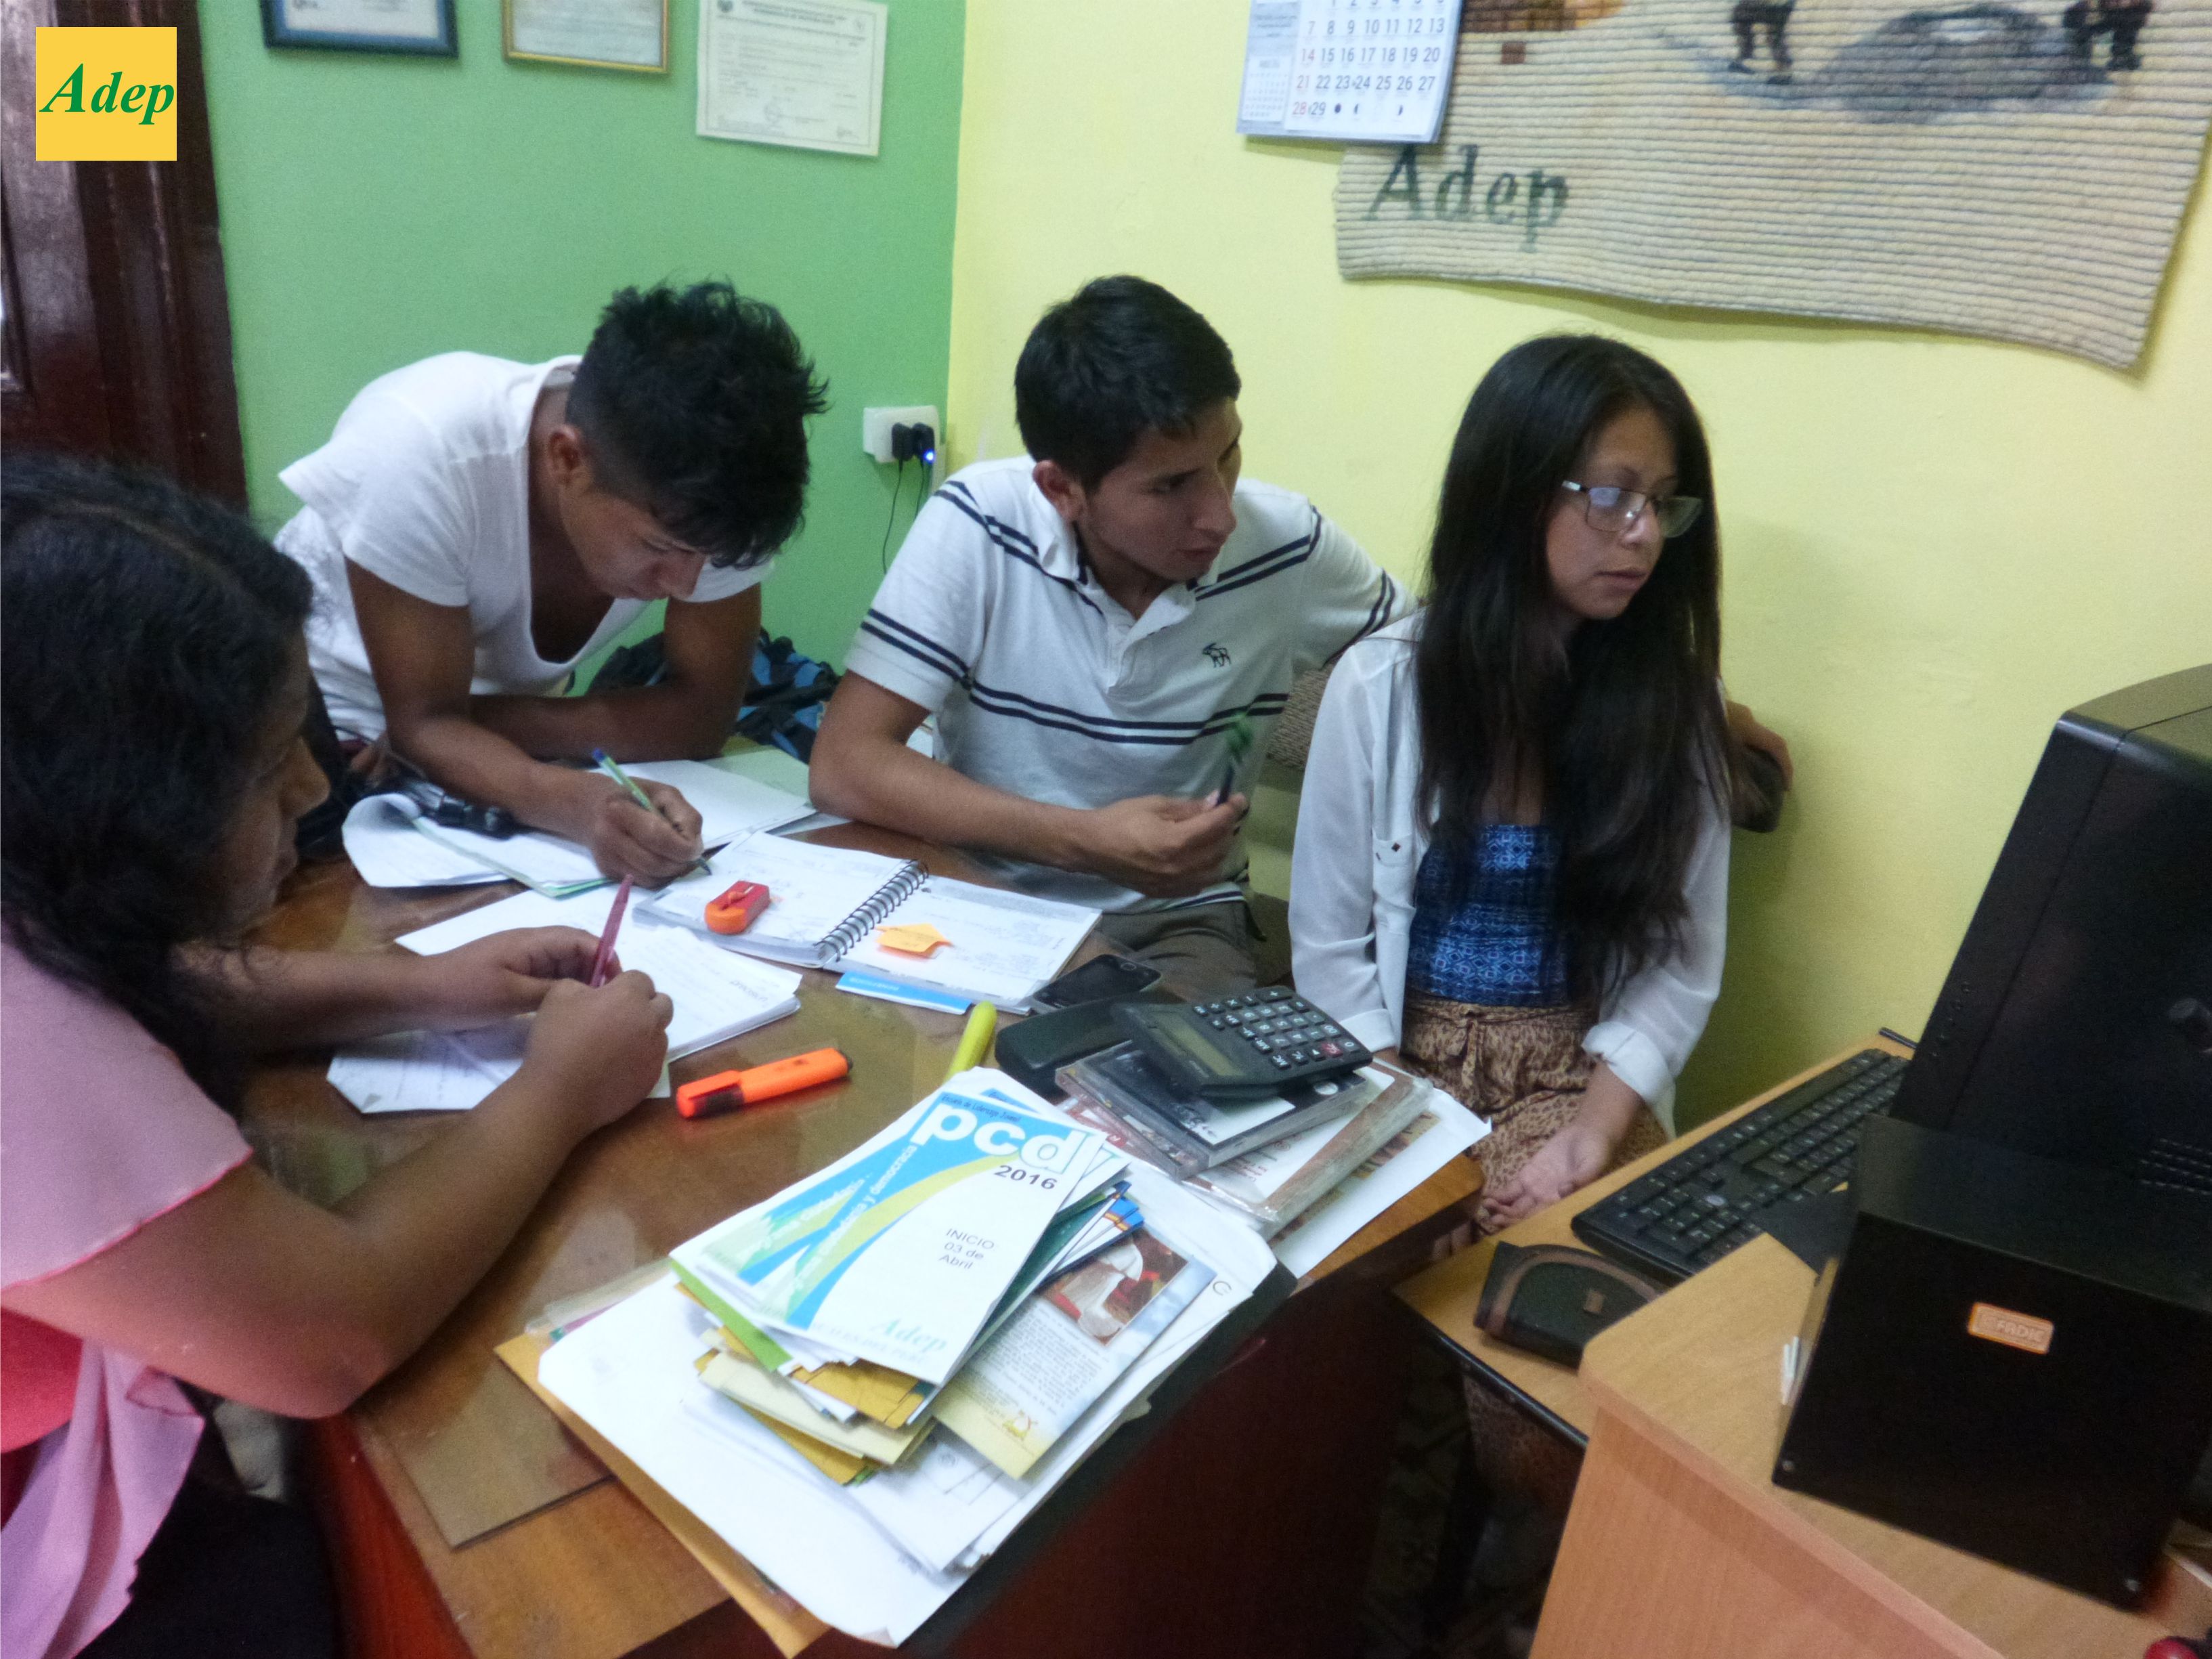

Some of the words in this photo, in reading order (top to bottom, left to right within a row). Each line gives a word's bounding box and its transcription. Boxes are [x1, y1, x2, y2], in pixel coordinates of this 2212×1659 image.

[1308, 21, 1316, 35] 7
[1327, 20, 1335, 34] 8
[1347, 20, 1355, 34] 9
[1365, 19, 1380, 34] 10
[1387, 19, 1400, 33] 11
[1408, 18, 1423, 33] 12
[1429, 18, 1444, 33] 13
[1301, 48, 1315, 61] 14
[1321, 48, 1335, 62] 15
[1341, 47, 1355, 62] 16
[1361, 47, 1376, 62] 17
[1382, 47, 1396, 62] 18
[1403, 47, 1418, 62] 19
[1423, 47, 1440, 62] 20
[1297, 74, 1309, 89] 21
[1316, 74, 1330, 89] 22
[1335, 75, 1351, 89] 23
[1355, 75, 1370, 89] 24
[1376, 75, 1391, 90] 25
[1396, 75, 1412, 90] 26
[1418, 76, 1435, 91] 27
[1292, 102, 1307, 115] 28
[1310, 102, 1326, 116] 29
[1360, 144, 1569, 253] Adep
[910, 1102, 1088, 1175] pcd
[869, 1143, 917, 1197] democracia
[993, 1164, 1058, 1190] 2016
[945, 1228, 995, 1249] INICIO
[944, 1242, 963, 1253] 03
[966, 1249, 984, 1259] de
[938, 1254, 974, 1270] Abril
